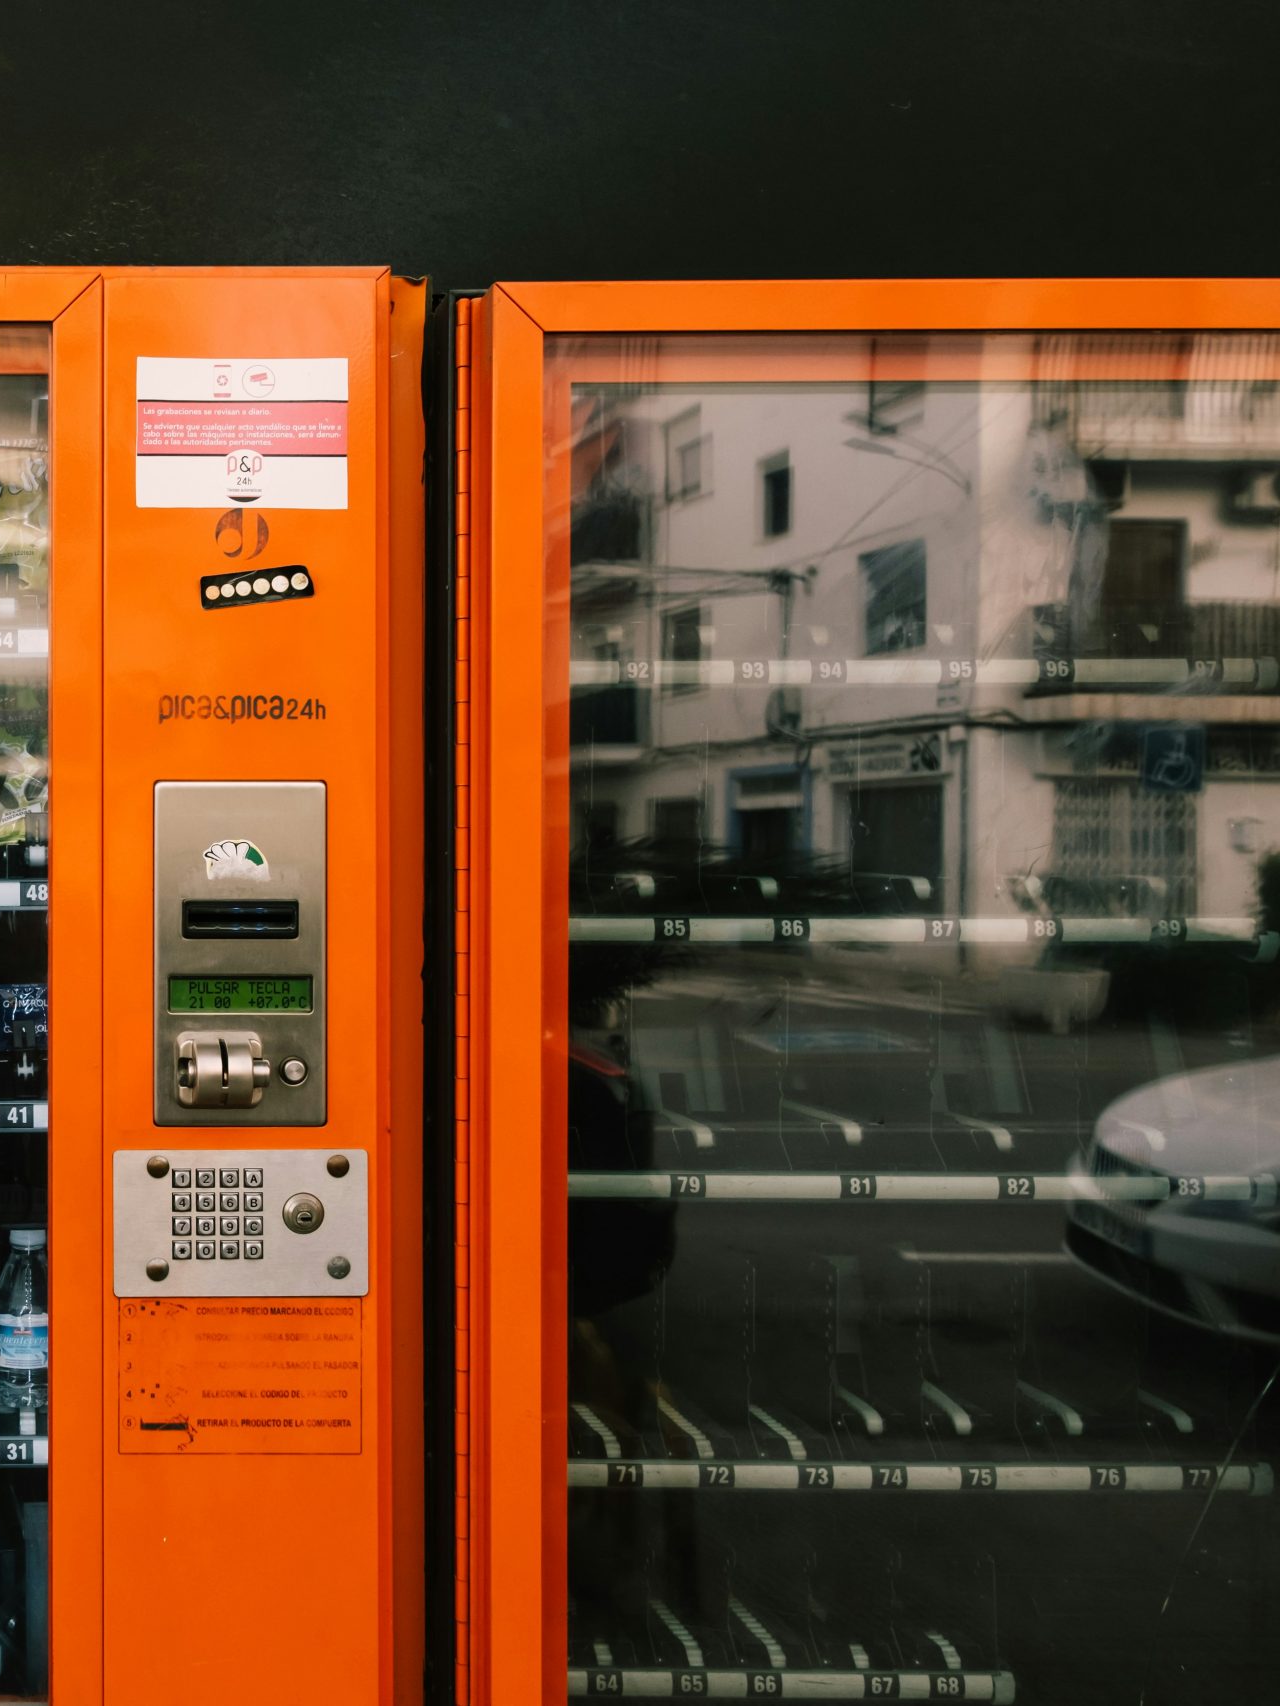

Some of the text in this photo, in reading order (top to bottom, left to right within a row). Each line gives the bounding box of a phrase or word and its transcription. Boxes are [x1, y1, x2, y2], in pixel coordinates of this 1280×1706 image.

[157, 408, 201, 417] grabaciones
[248, 408, 272, 416] diario.
[236, 476, 252, 485] 24h
[628, 662, 649, 678] 92
[742, 662, 764, 678] 93
[820, 663, 841, 678] 94
[950, 662, 971, 678] 95
[1046, 661, 1068, 677] 96
[26, 884, 48, 900] 48
[664, 920, 685, 936] 85
[782, 920, 803, 936] 86
[932, 920, 954, 936] 87
[1034, 920, 1056, 935] 88
[1159, 920, 1180, 936] 89
[188, 981, 291, 995] PULSAR TECLA
[189, 996, 205, 1009] 21
[214, 996, 231, 1009] 00
[8, 1107, 28, 1123] 41
[203, 1175, 209, 1183] 2
[227, 1175, 233, 1183] 3
[250, 1175, 257, 1183] A
[679, 1177, 700, 1194] 79
[850, 1178, 871, 1194] 81
[1008, 1179, 1029, 1196] 82
[1178, 1180, 1200, 1195] 83
[179, 1199, 186, 1207] 4
[203, 1199, 210, 1207] 5
[227, 1199, 233, 1207] 6
[251, 1199, 257, 1207] B
[180, 1222, 186, 1231] 7
[203, 1222, 210, 1231] 8
[227, 1222, 233, 1231] 9
[250, 1222, 257, 1231] C
[203, 1247, 210, 1255] 0
[251, 1247, 257, 1255] D
[7, 1444, 28, 1460] 31
[617, 1466, 637, 1482] 71
[707, 1466, 729, 1484] 72
[807, 1468, 828, 1484] 73
[880, 1469, 902, 1486] 74
[970, 1468, 992, 1485] 75
[1098, 1469, 1120, 1486] 76
[1189, 1469, 1210, 1486] 77
[596, 1675, 618, 1692] 64
[682, 1675, 703, 1692] 65
[754, 1675, 776, 1692] 66
[872, 1677, 893, 1694] 67
[937, 1677, 959, 1694] 68
